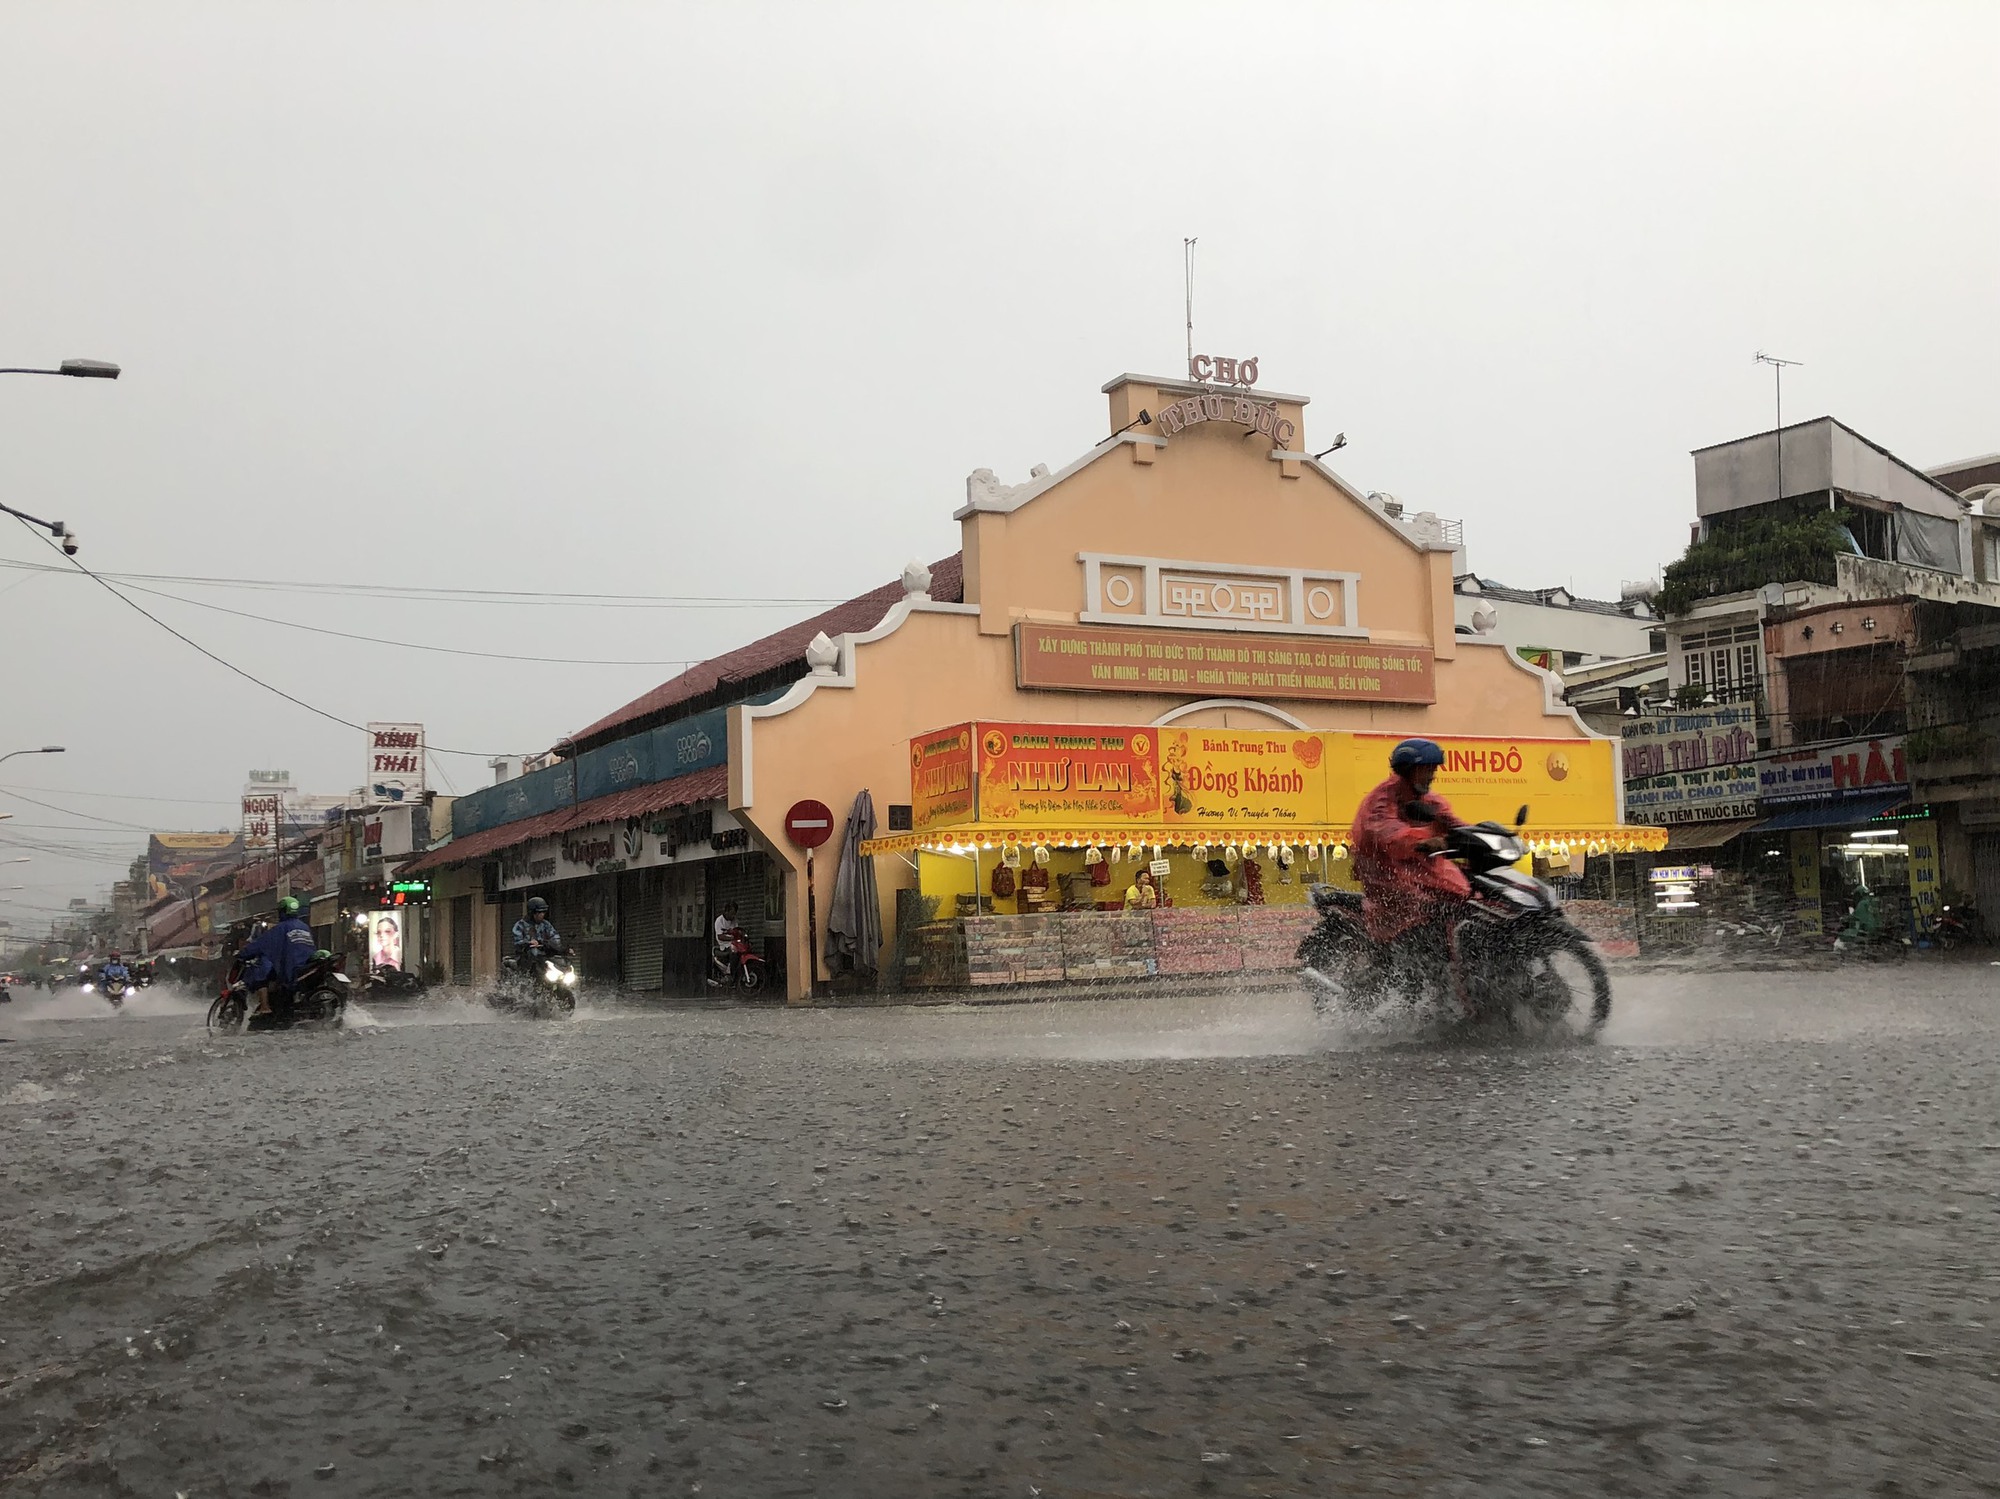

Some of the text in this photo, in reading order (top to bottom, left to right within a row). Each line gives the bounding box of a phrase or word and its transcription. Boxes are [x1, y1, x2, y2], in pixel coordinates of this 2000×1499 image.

[1190, 354, 1259, 393] CHỢ
[1158, 383, 1295, 444] THỦ ĐỨC
[1039, 636, 1058, 653] XÂY
[1061, 638, 1087, 657] DỰNG
[1090, 639, 1121, 656] THÀNH
[1124, 639, 1143, 657] PHỐ
[1145, 641, 1163, 659] THỦ
[1165, 643, 1184, 660] ĐỨC
[1186, 643, 1204, 661] TRỞ
[1206, 645, 1236, 663] THÀNH
[1238, 647, 1250, 663] ĐÔ
[1252, 650, 1266, 667] THỊ
[1268, 648, 1292, 665] SÁNG
[1294, 652, 1313, 669] TẠO,
[1315, 651, 1327, 667] CÓ
[1329, 651, 1351, 668] CHẤT
[1353, 654, 1380, 672] LƯỢNG
[1382, 654, 1405, 671] SỐNG
[1091, 662, 1111, 679] VĂN
[1114, 666, 1139, 680] MINH
[1148, 665, 1170, 684] HIỆN
[1172, 669, 1188, 685] ĐẠI
[1197, 668, 1225, 685] NGHĨA
[1252, 670, 1274, 686] PHÁT
[1277, 669, 1302, 688] TRIỂN
[1304, 675, 1336, 690] NHANH,
[1358, 675, 1381, 691] VỮNG
[1012, 732, 1125, 751] BÁNH TRUNG THU
[1202, 739, 1287, 756] Bánh Trung Thu
[1622, 726, 1755, 778] NEM THỦ ĐỨC
[1007, 756, 1131, 792] NHƯ LAN
[1489, 746, 1523, 773] ĐÔ
[1187, 761, 1303, 798] Đồng Khánh
[1228, 807, 1238, 820] Vị
[1695, 802, 1731, 819] THUỐC
